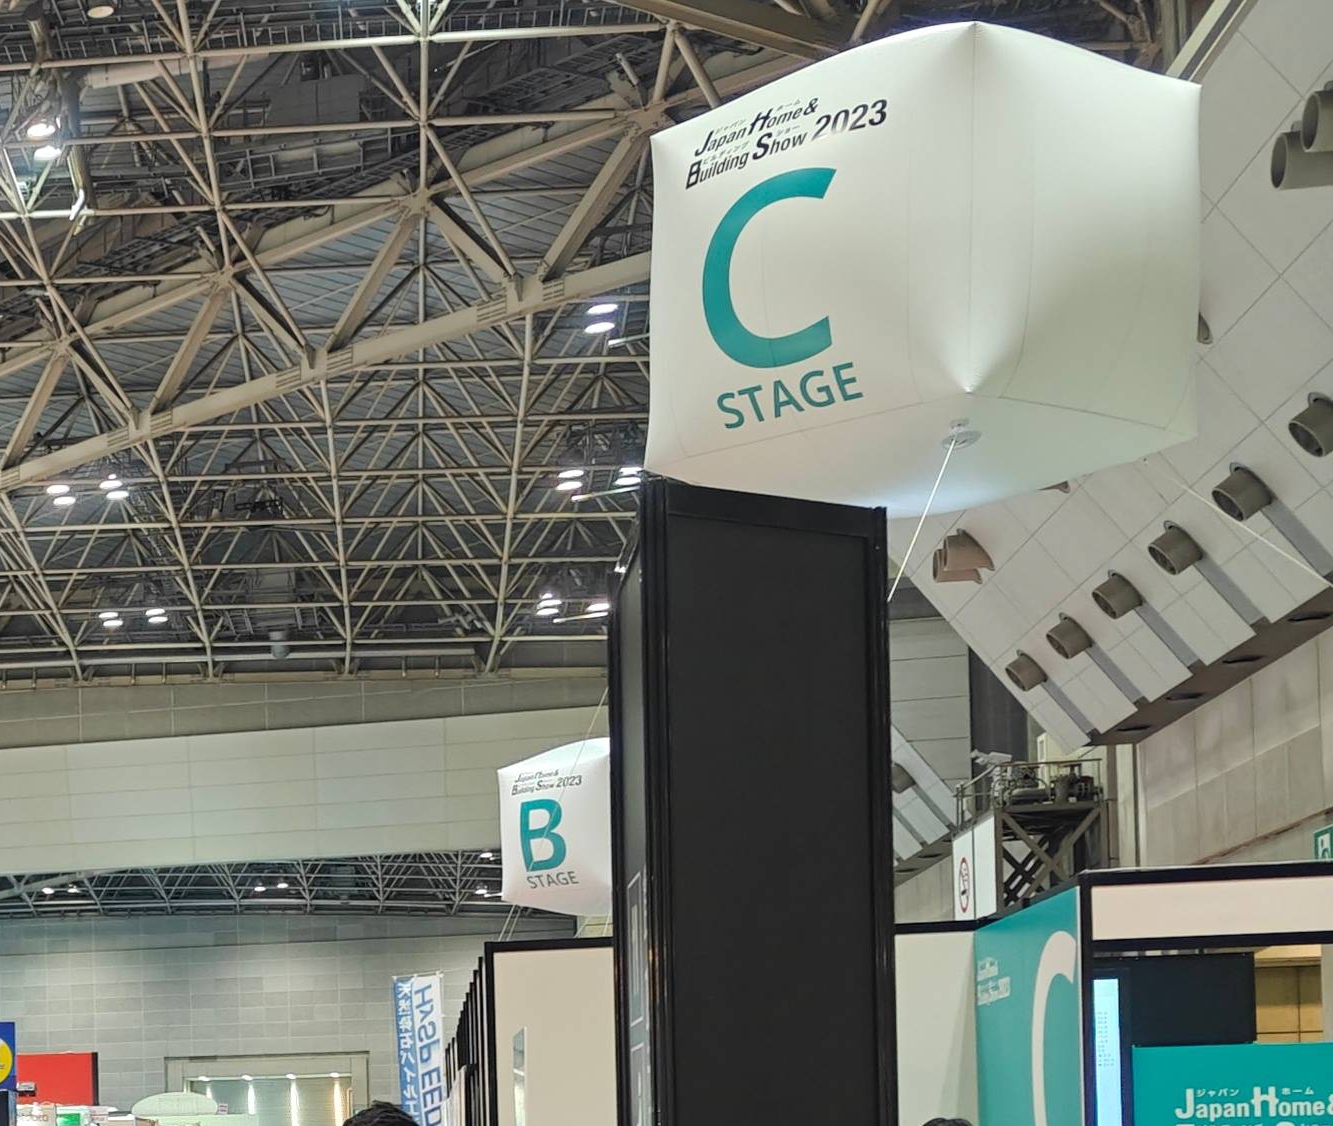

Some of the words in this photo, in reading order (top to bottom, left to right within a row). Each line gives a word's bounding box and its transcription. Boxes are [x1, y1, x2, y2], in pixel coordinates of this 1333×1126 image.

[685, 152, 749, 190] Building
[752, 132, 808, 160] Show
[811, 99, 888, 143] 2023
[694, 129, 747, 157] Japan
[748, 97, 819, 137] Home&
[702, 167, 837, 369] C
[716, 362, 864, 430] STAGE
[512, 784, 535, 796] Building
[535, 780, 554, 791] Show
[556, 775, 583, 788] 2023
[520, 798, 567, 872] B
[526, 871, 580, 889] STAGE
[1175, 1088, 1250, 1122] Japan
